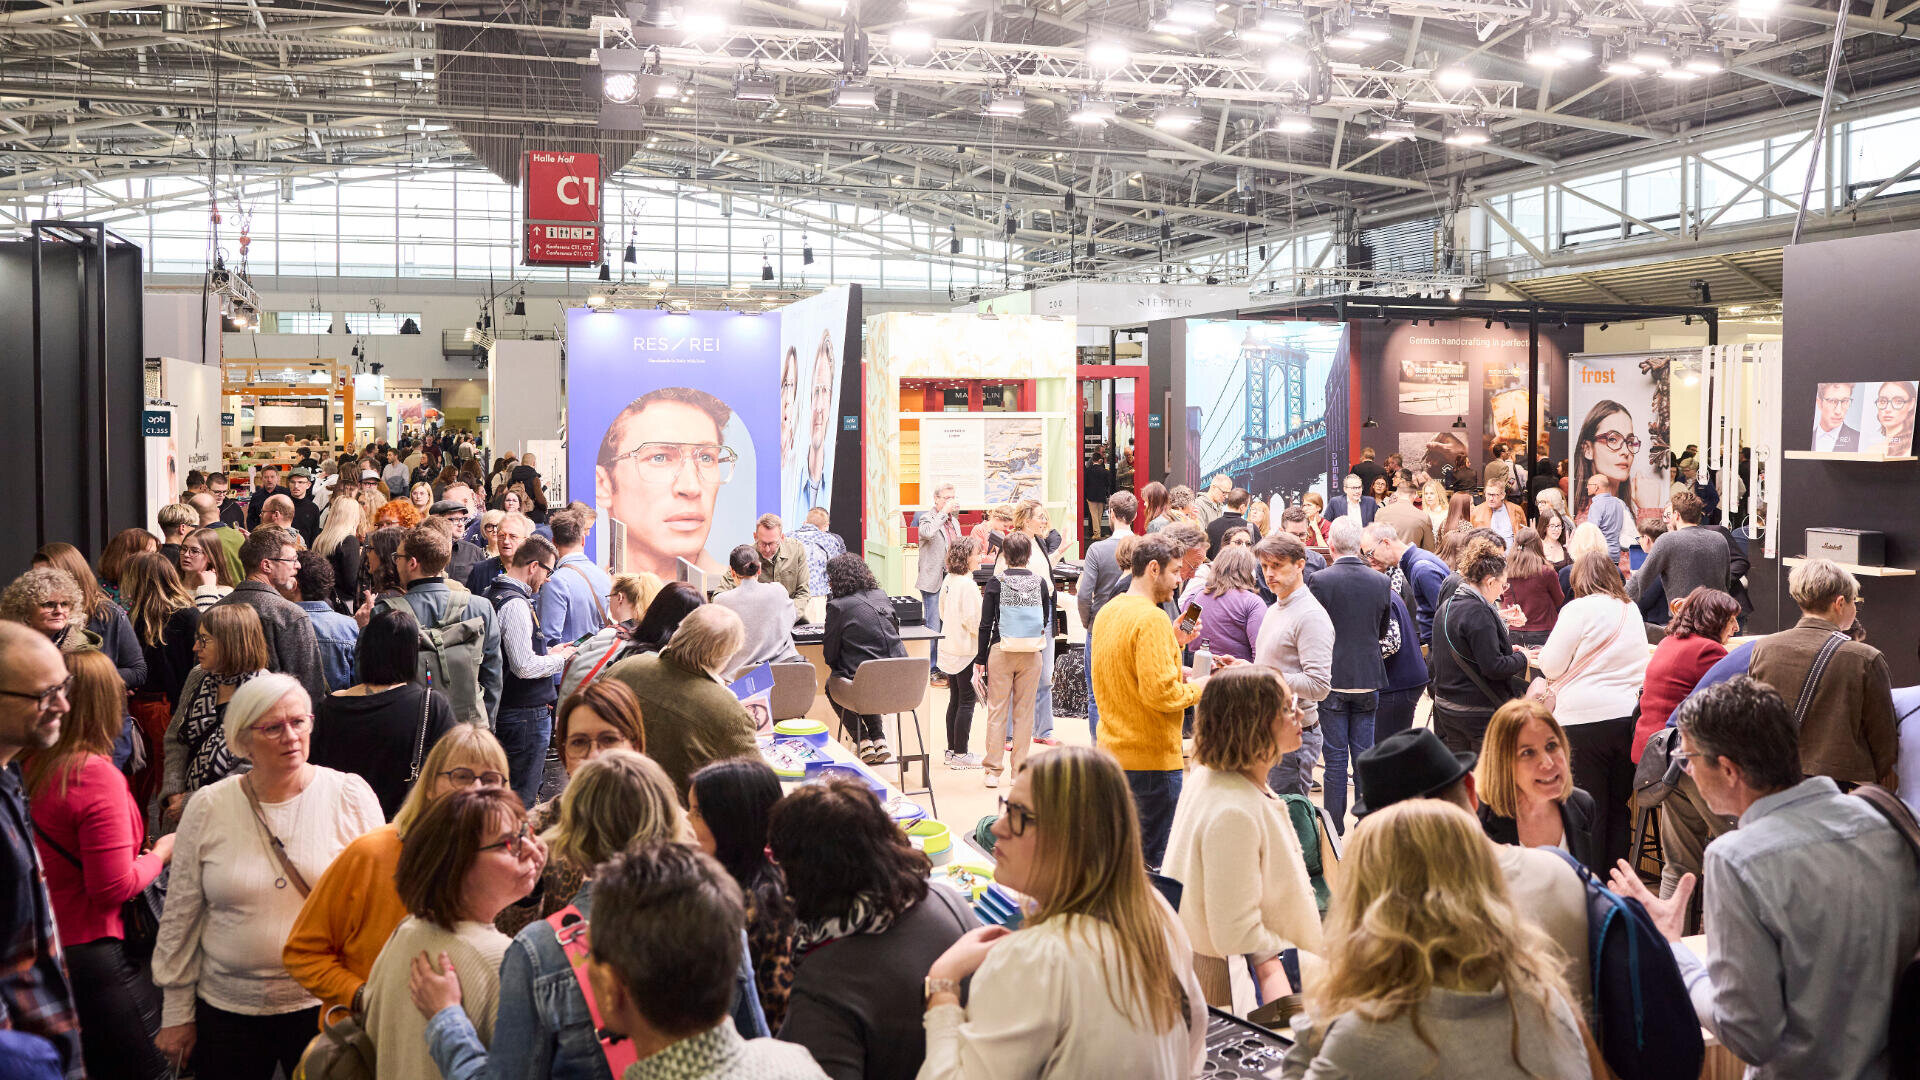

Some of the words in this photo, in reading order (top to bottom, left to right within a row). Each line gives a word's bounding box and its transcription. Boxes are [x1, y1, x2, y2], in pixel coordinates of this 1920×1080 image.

[533, 154, 555, 163] Halle
[557, 155, 575, 164] Hall
[557, 175, 596, 206] C1
[1409, 336, 1440, 346] German
[1441, 337, 1490, 348] handcrafting
[1581, 365, 1616, 385] frost
[147, 415, 166, 425] opti
